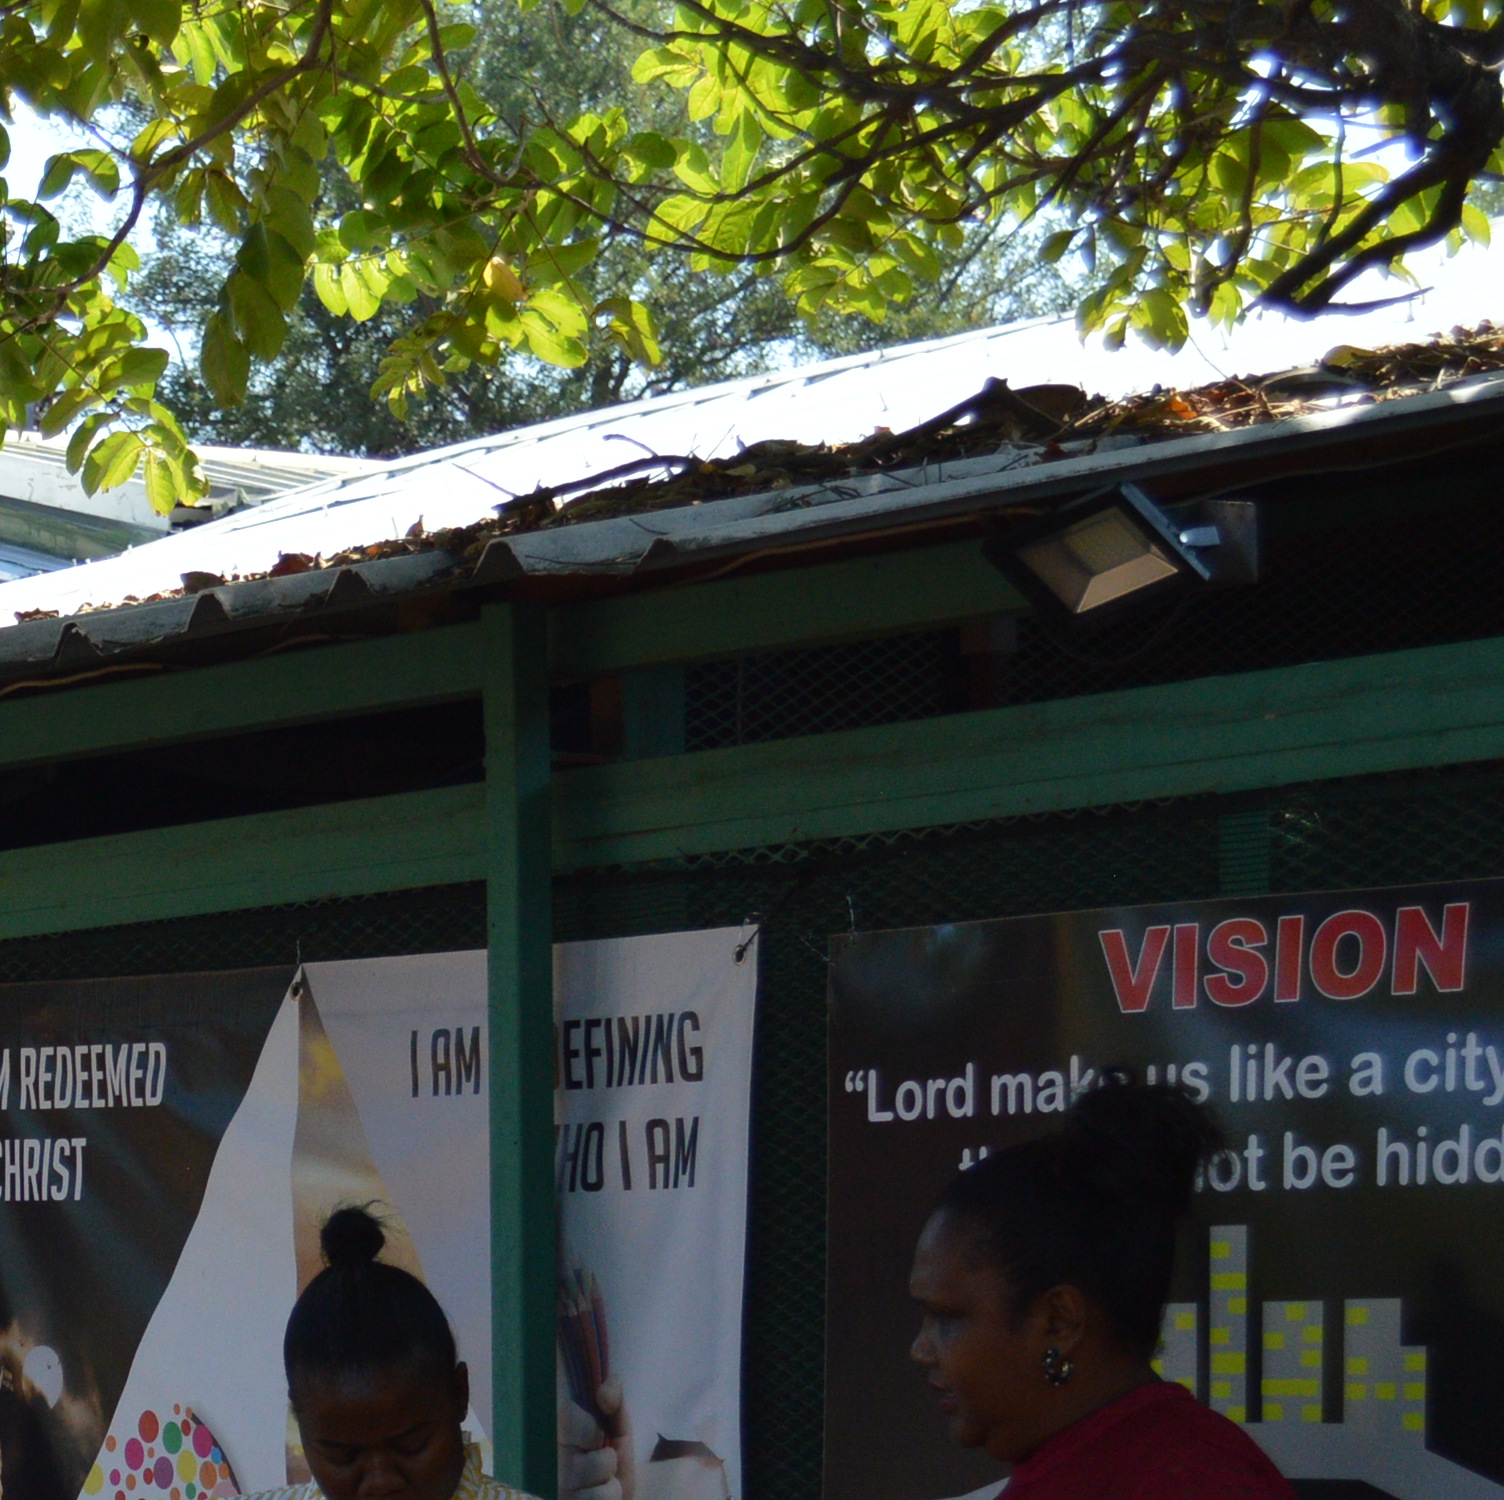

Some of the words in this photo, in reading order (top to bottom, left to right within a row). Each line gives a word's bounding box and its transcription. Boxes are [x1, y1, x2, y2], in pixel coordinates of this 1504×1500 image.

[1097, 902, 1470, 1014] VISION
[19, 1041, 168, 1111] REDEEMED
[410, 1030, 419, 1098] I
[430, 1026, 482, 1097] AM
[553, 1011, 704, 1090] EFINING
[844, 1061, 974, 1123] “Lord
[1229, 1042, 1330, 1102] like
[1348, 1050, 1384, 1096] a
[618, 1120, 633, 1191] I
[645, 1116, 700, 1190] AM
[1283, 1130, 1356, 1190] be
